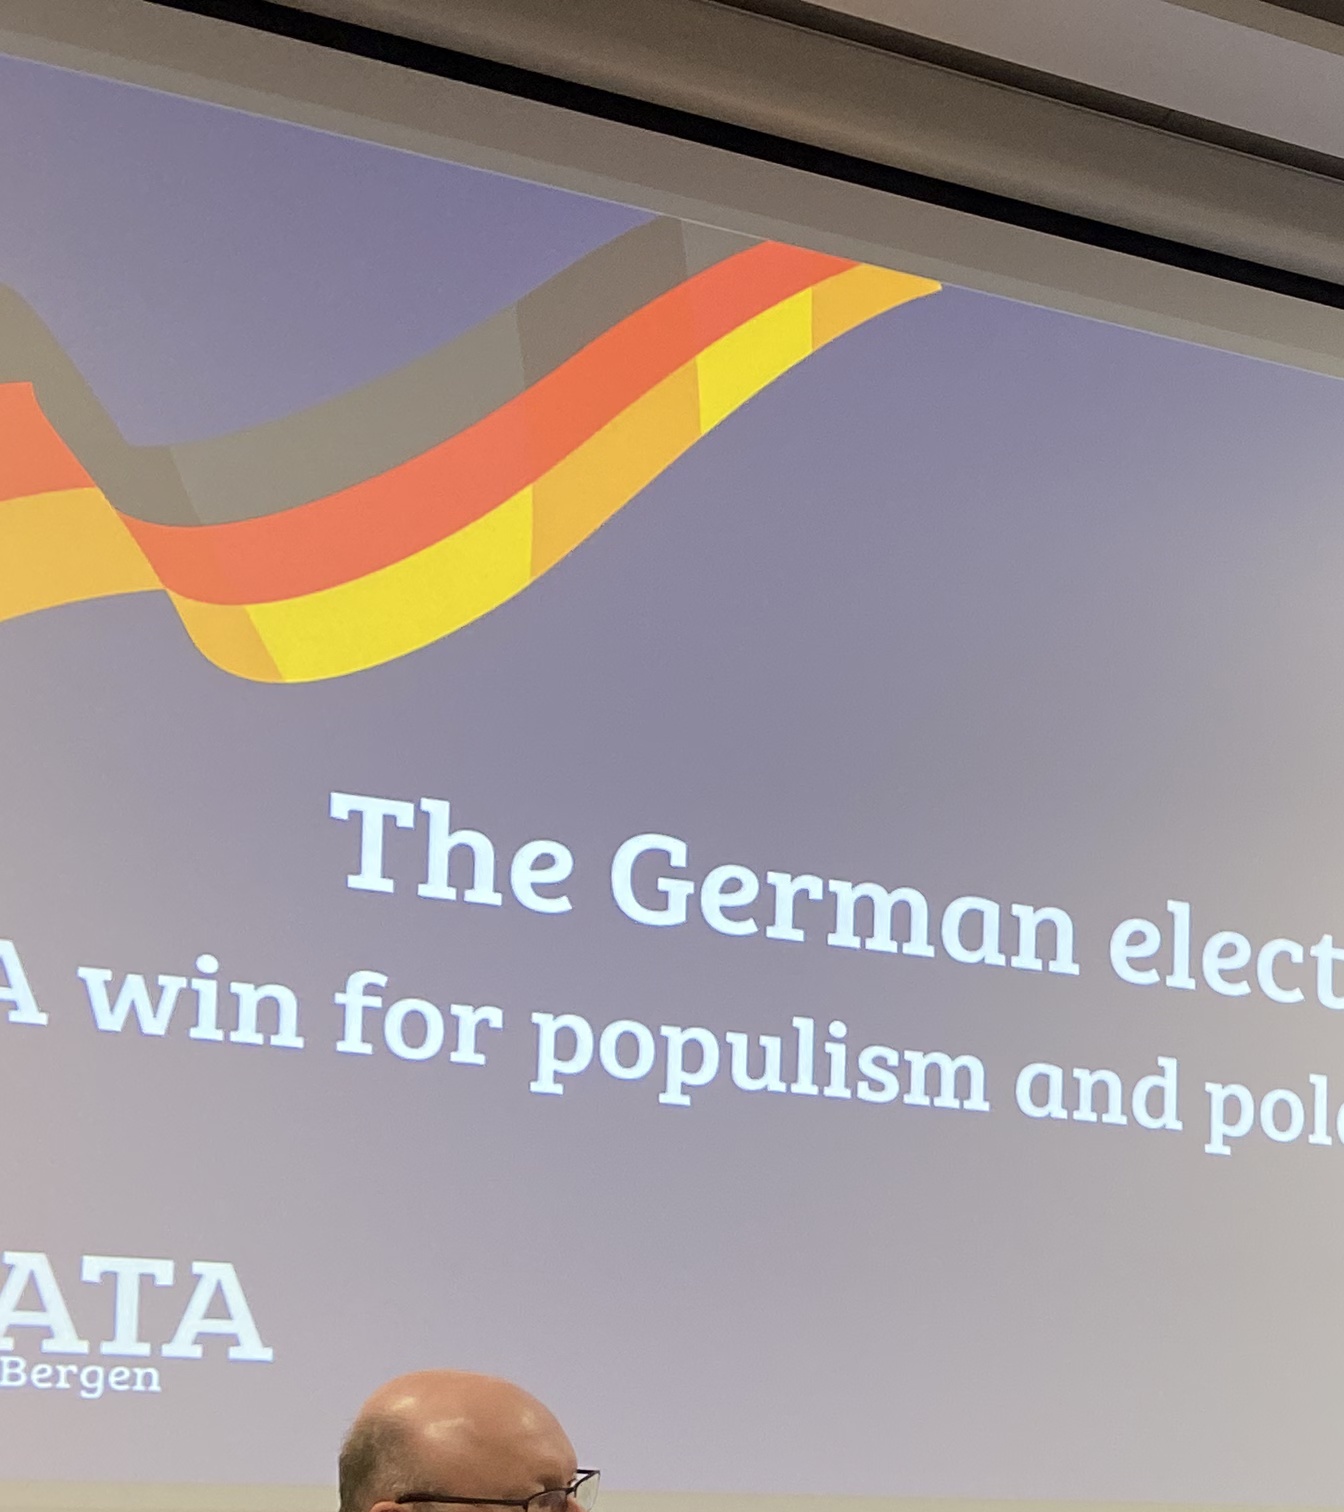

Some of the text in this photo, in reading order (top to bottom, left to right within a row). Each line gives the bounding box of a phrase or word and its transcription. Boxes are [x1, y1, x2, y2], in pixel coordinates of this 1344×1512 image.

[330, 791, 575, 913] The
[610, 833, 1080, 976] German
[0, 938, 48, 1025] A
[77, 954, 304, 1049] win
[334, 970, 504, 1066] for
[529, 1012, 990, 1112] populism
[1014, 1056, 1182, 1132] and
[0, 1355, 161, 1399] Bergen
